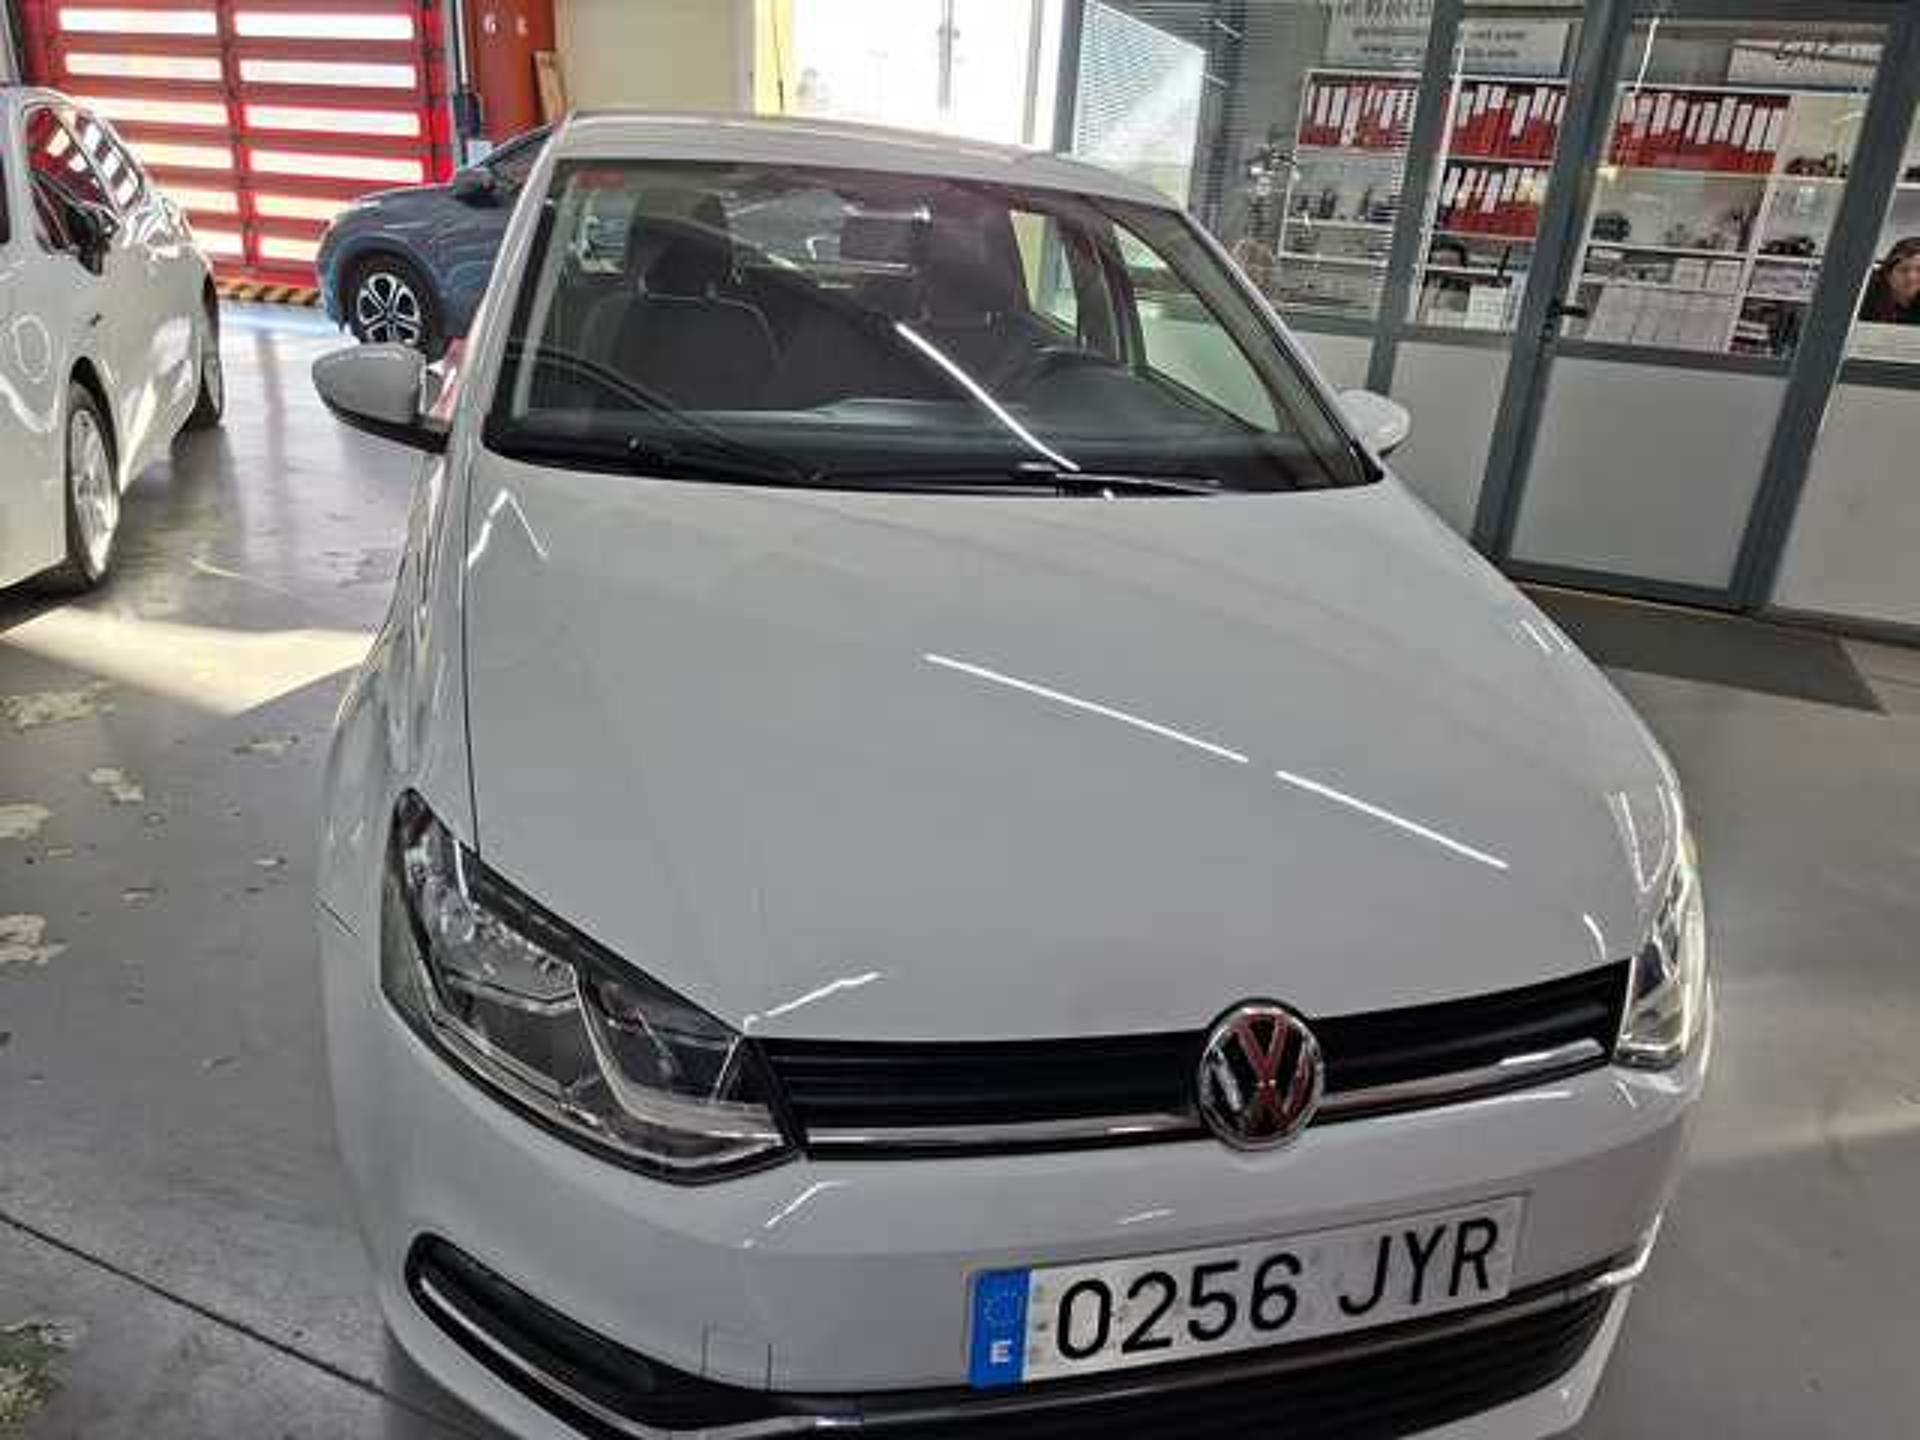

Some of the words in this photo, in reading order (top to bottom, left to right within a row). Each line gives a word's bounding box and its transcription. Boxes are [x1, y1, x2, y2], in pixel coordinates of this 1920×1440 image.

[1055, 1252, 1302, 1360] 0256
[1337, 1216, 1499, 1317] JYR
[989, 1339, 1013, 1364] E
